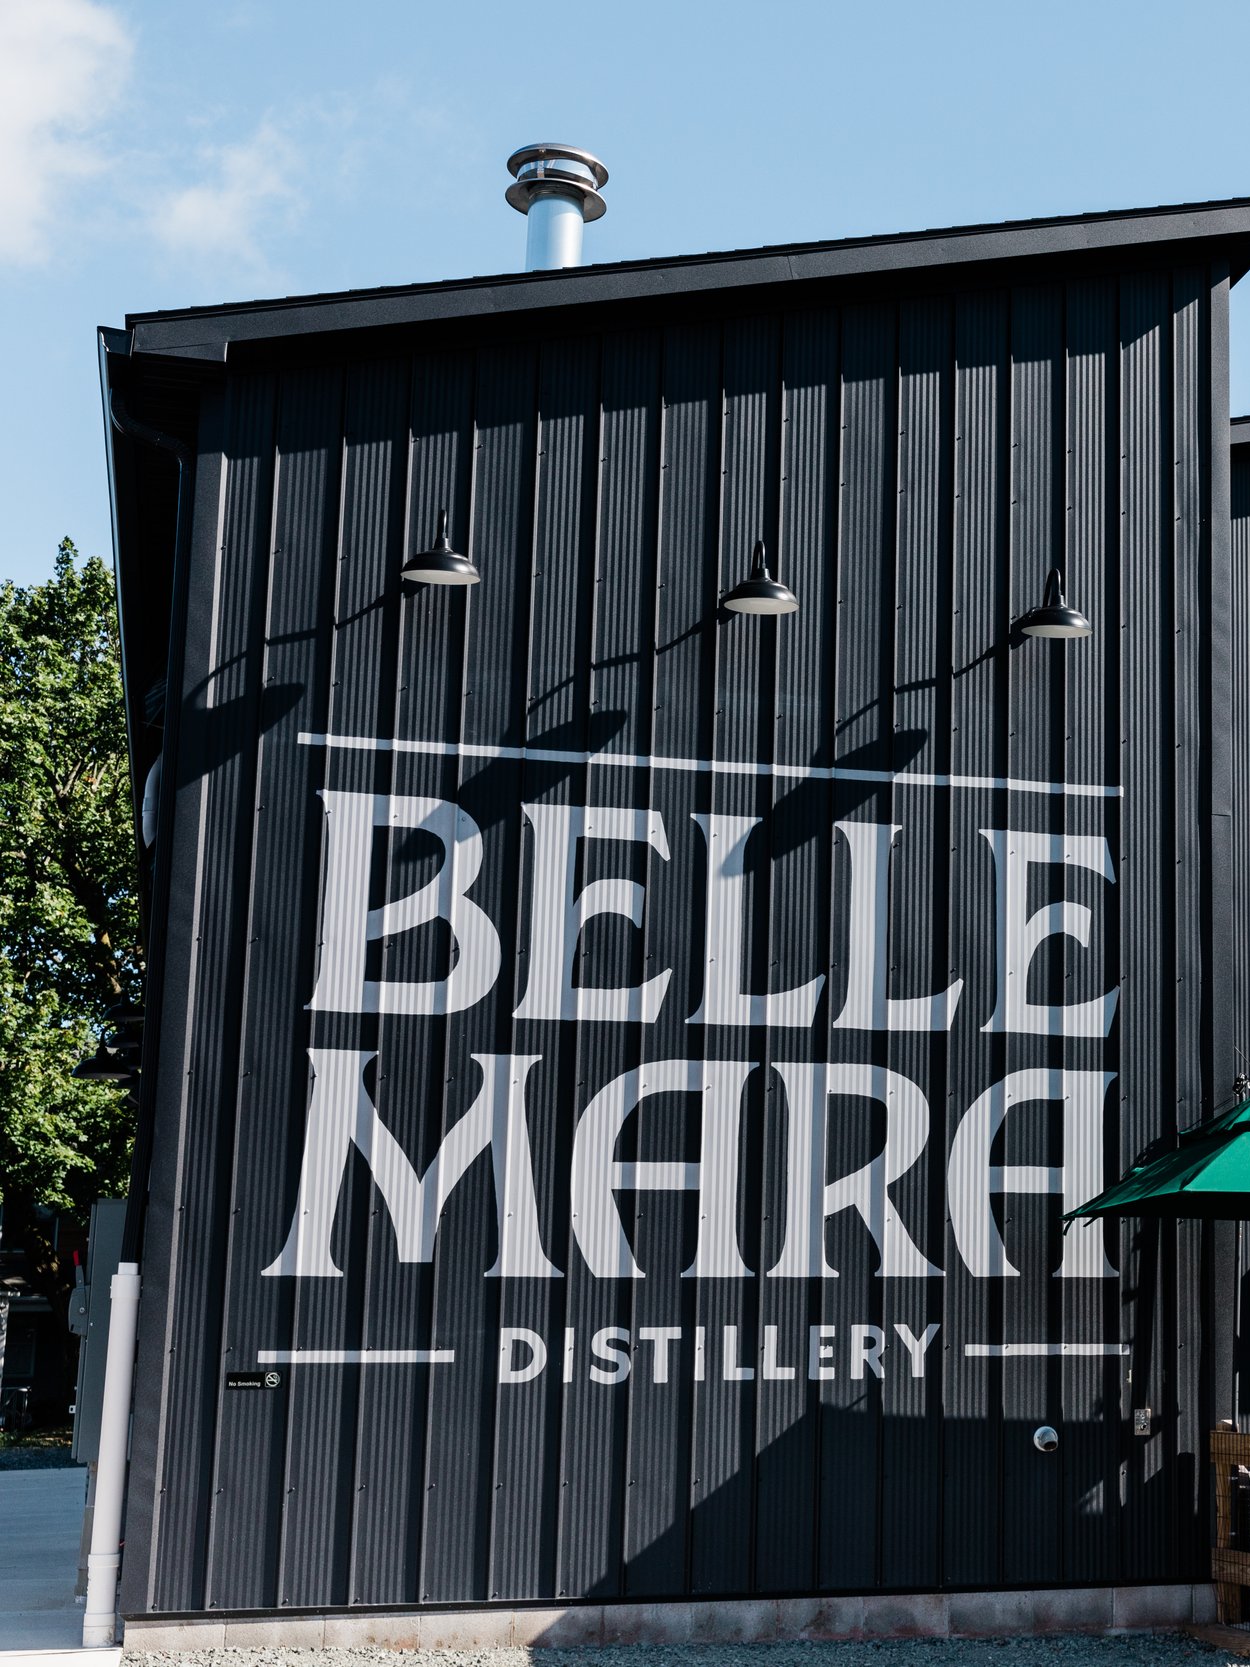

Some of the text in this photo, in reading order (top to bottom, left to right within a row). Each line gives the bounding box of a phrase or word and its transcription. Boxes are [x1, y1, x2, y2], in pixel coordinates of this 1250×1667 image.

[304, 789, 1120, 1038] BELLE
[260, 1048, 1120, 1279] MARA
[499, 1323, 941, 1385] DISTILLERY
